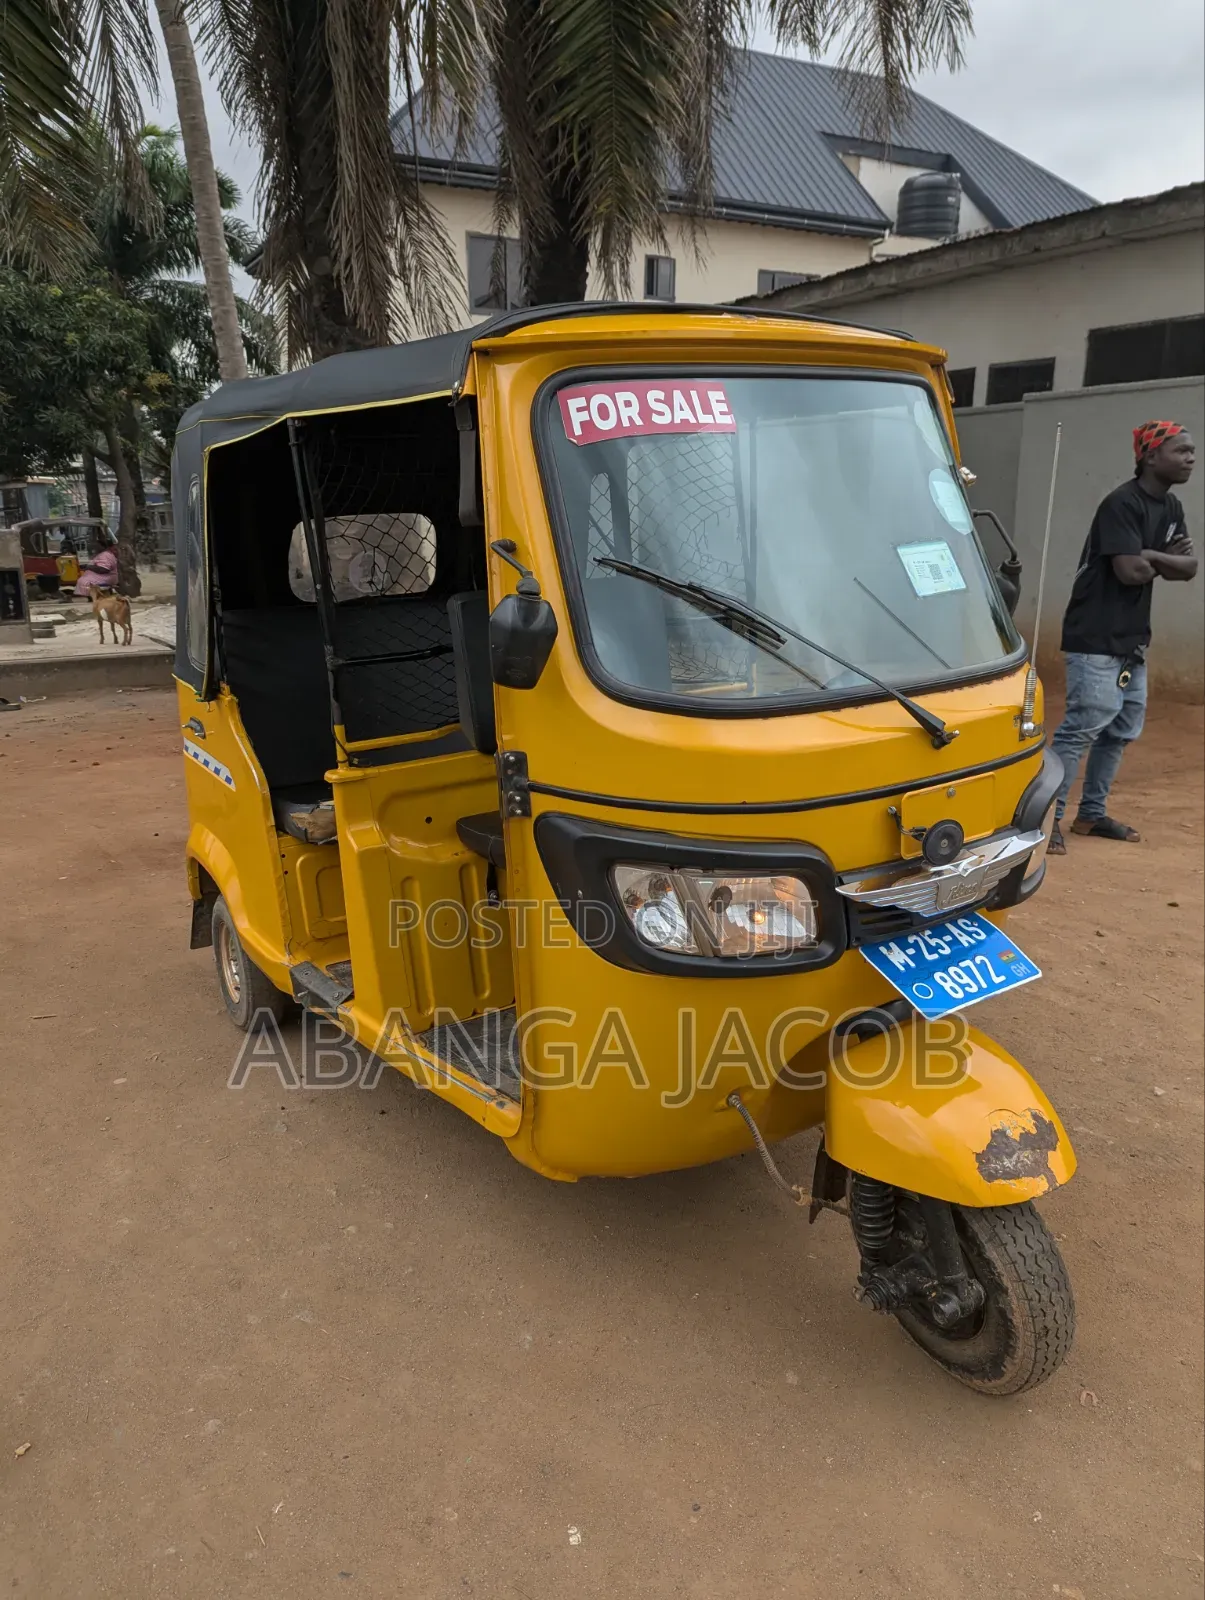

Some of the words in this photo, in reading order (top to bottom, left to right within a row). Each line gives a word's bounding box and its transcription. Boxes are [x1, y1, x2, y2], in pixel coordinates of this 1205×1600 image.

[567, 391, 644, 436] FOR
[646, 389, 733, 425] SALE
[878, 918, 987, 971] M-25-AS
[933, 955, 1006, 1000] 8972
[1011, 962, 1031, 978] GH
